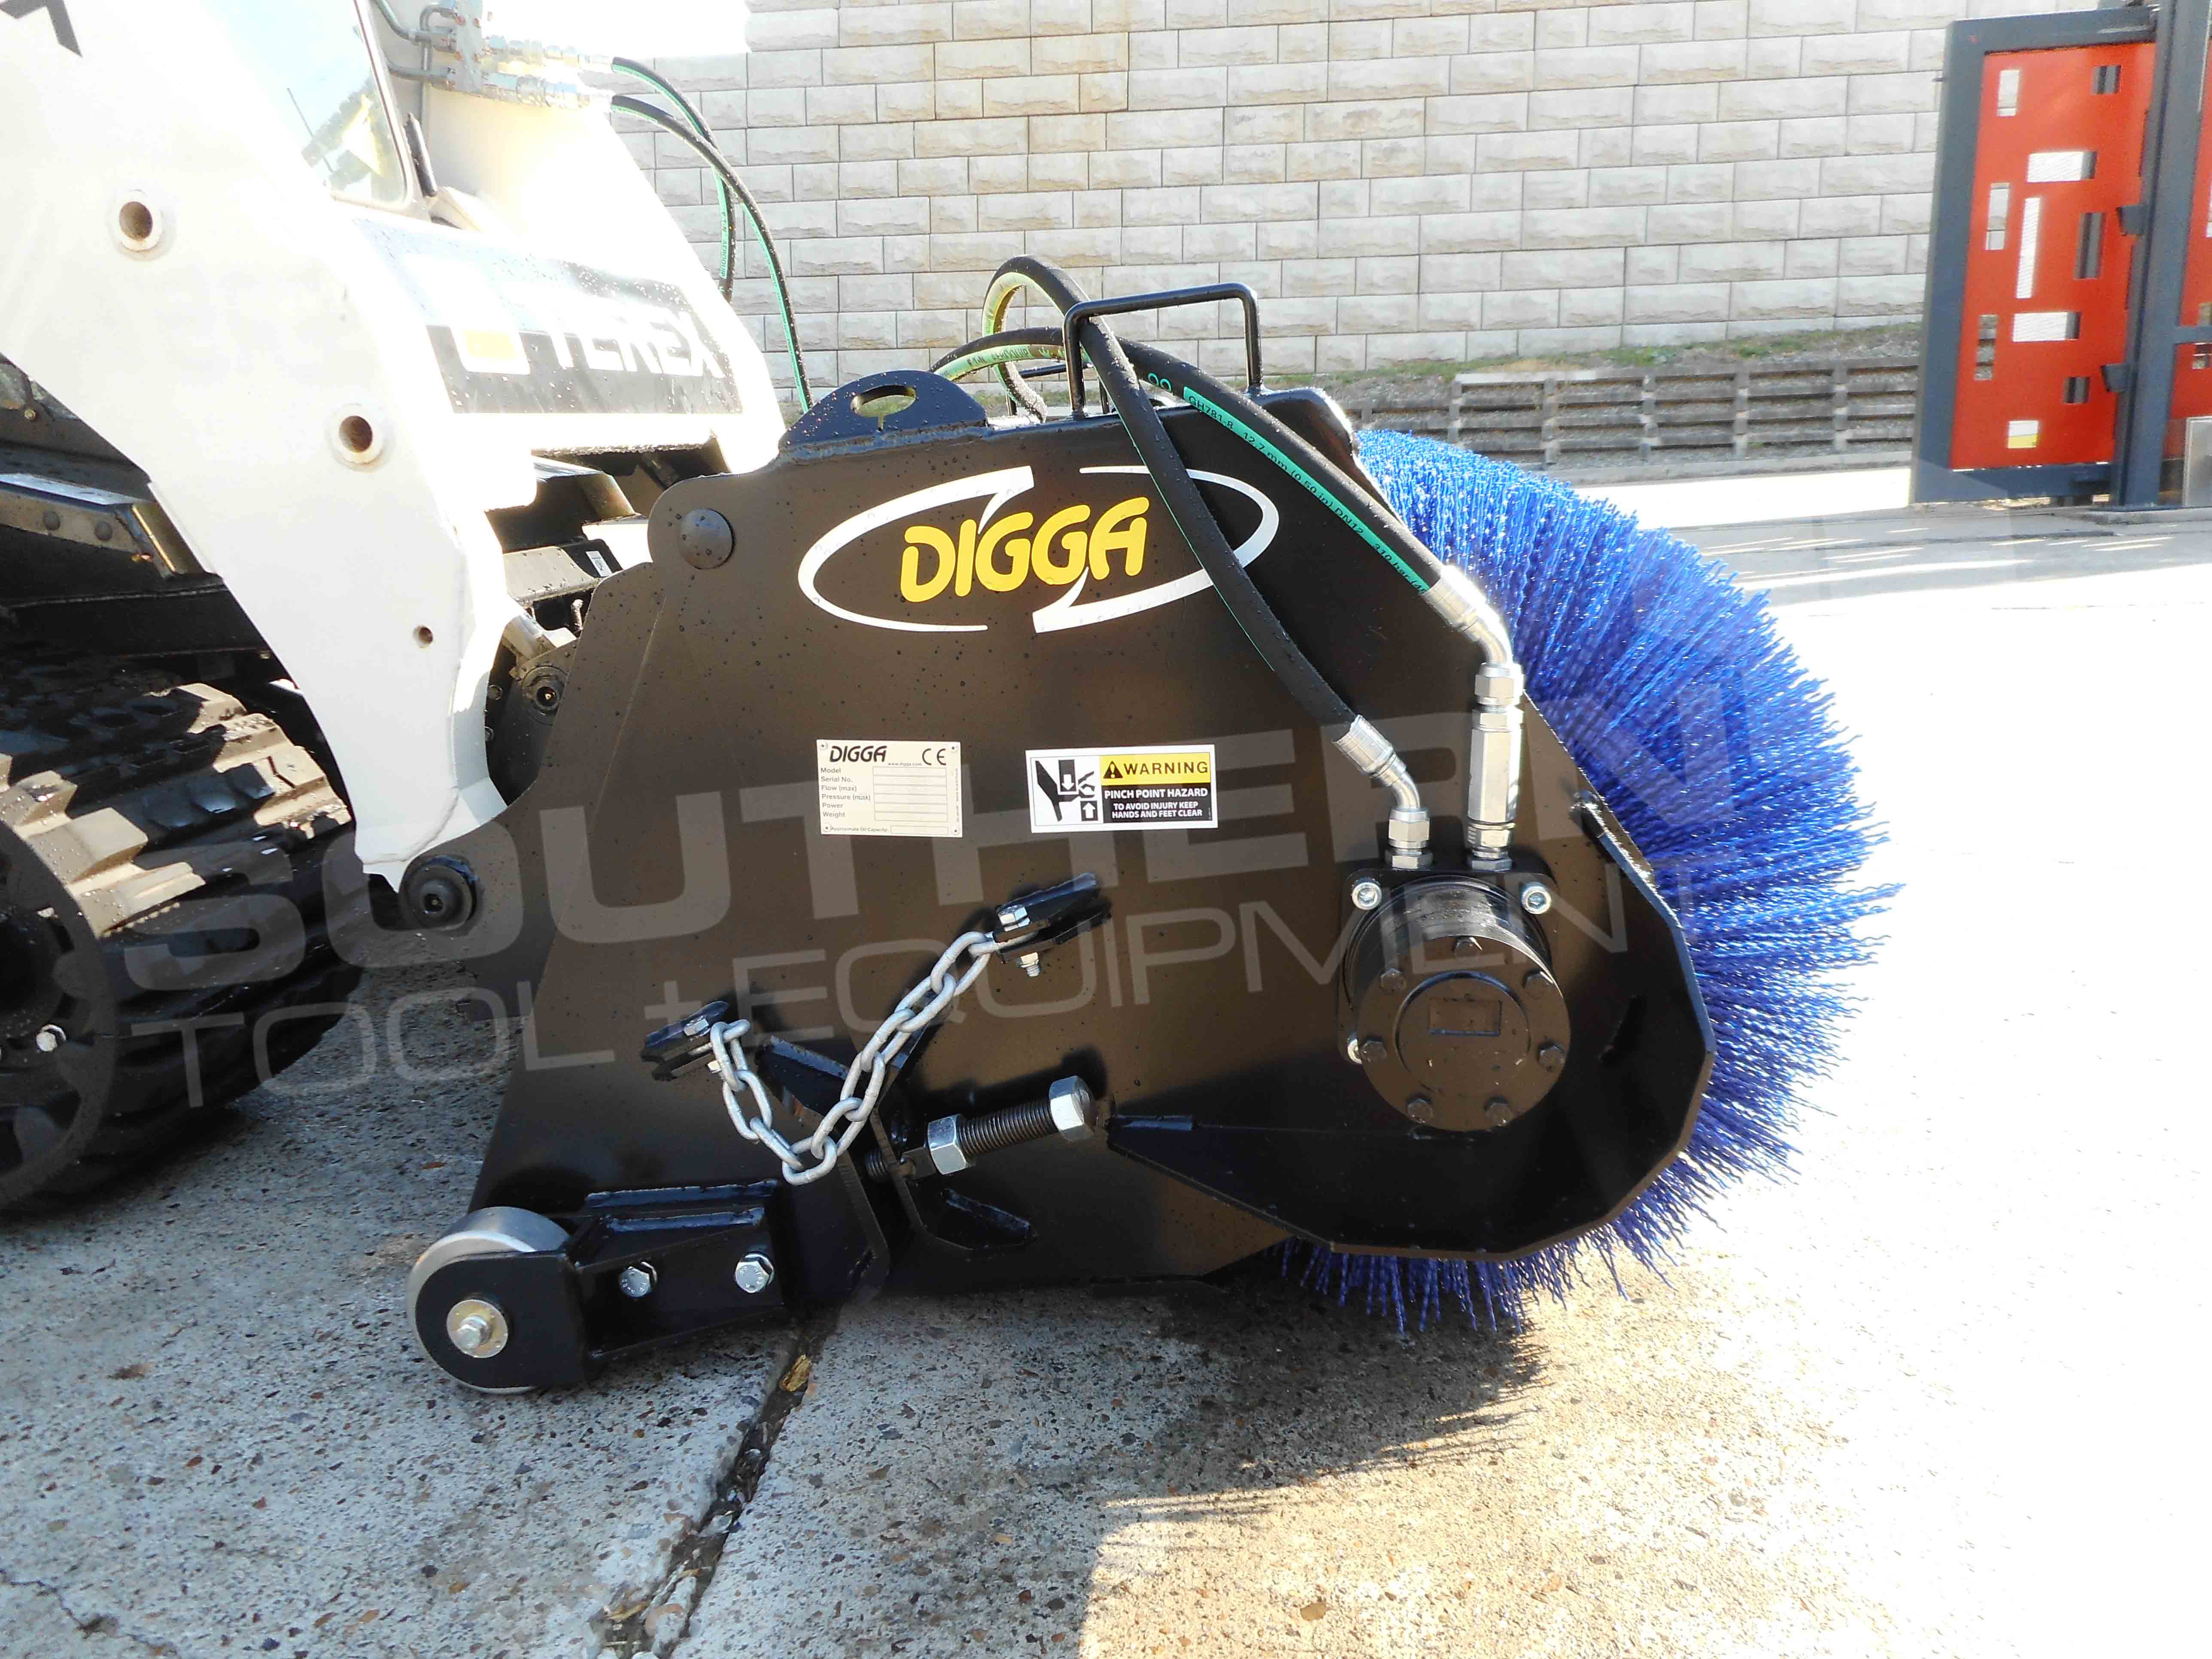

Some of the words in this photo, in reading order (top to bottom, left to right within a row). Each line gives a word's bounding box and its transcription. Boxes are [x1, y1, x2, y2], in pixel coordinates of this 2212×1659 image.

[1243, 432, 1266, 450] 12.7
[1267, 452, 1288, 470] mm
[1319, 493, 1333, 507] in)
[1334, 507, 1364, 533] DN12
[1374, 543, 1392, 562] 310
[899, 496, 1150, 603] DIGGA
[830, 745, 887, 763] DIGGA
[1123, 761, 1208, 775] WARNING
[1104, 790, 1134, 799] PINCH
[1136, 789, 1166, 799] POINT
[1167, 788, 1208, 797] HAZARD
